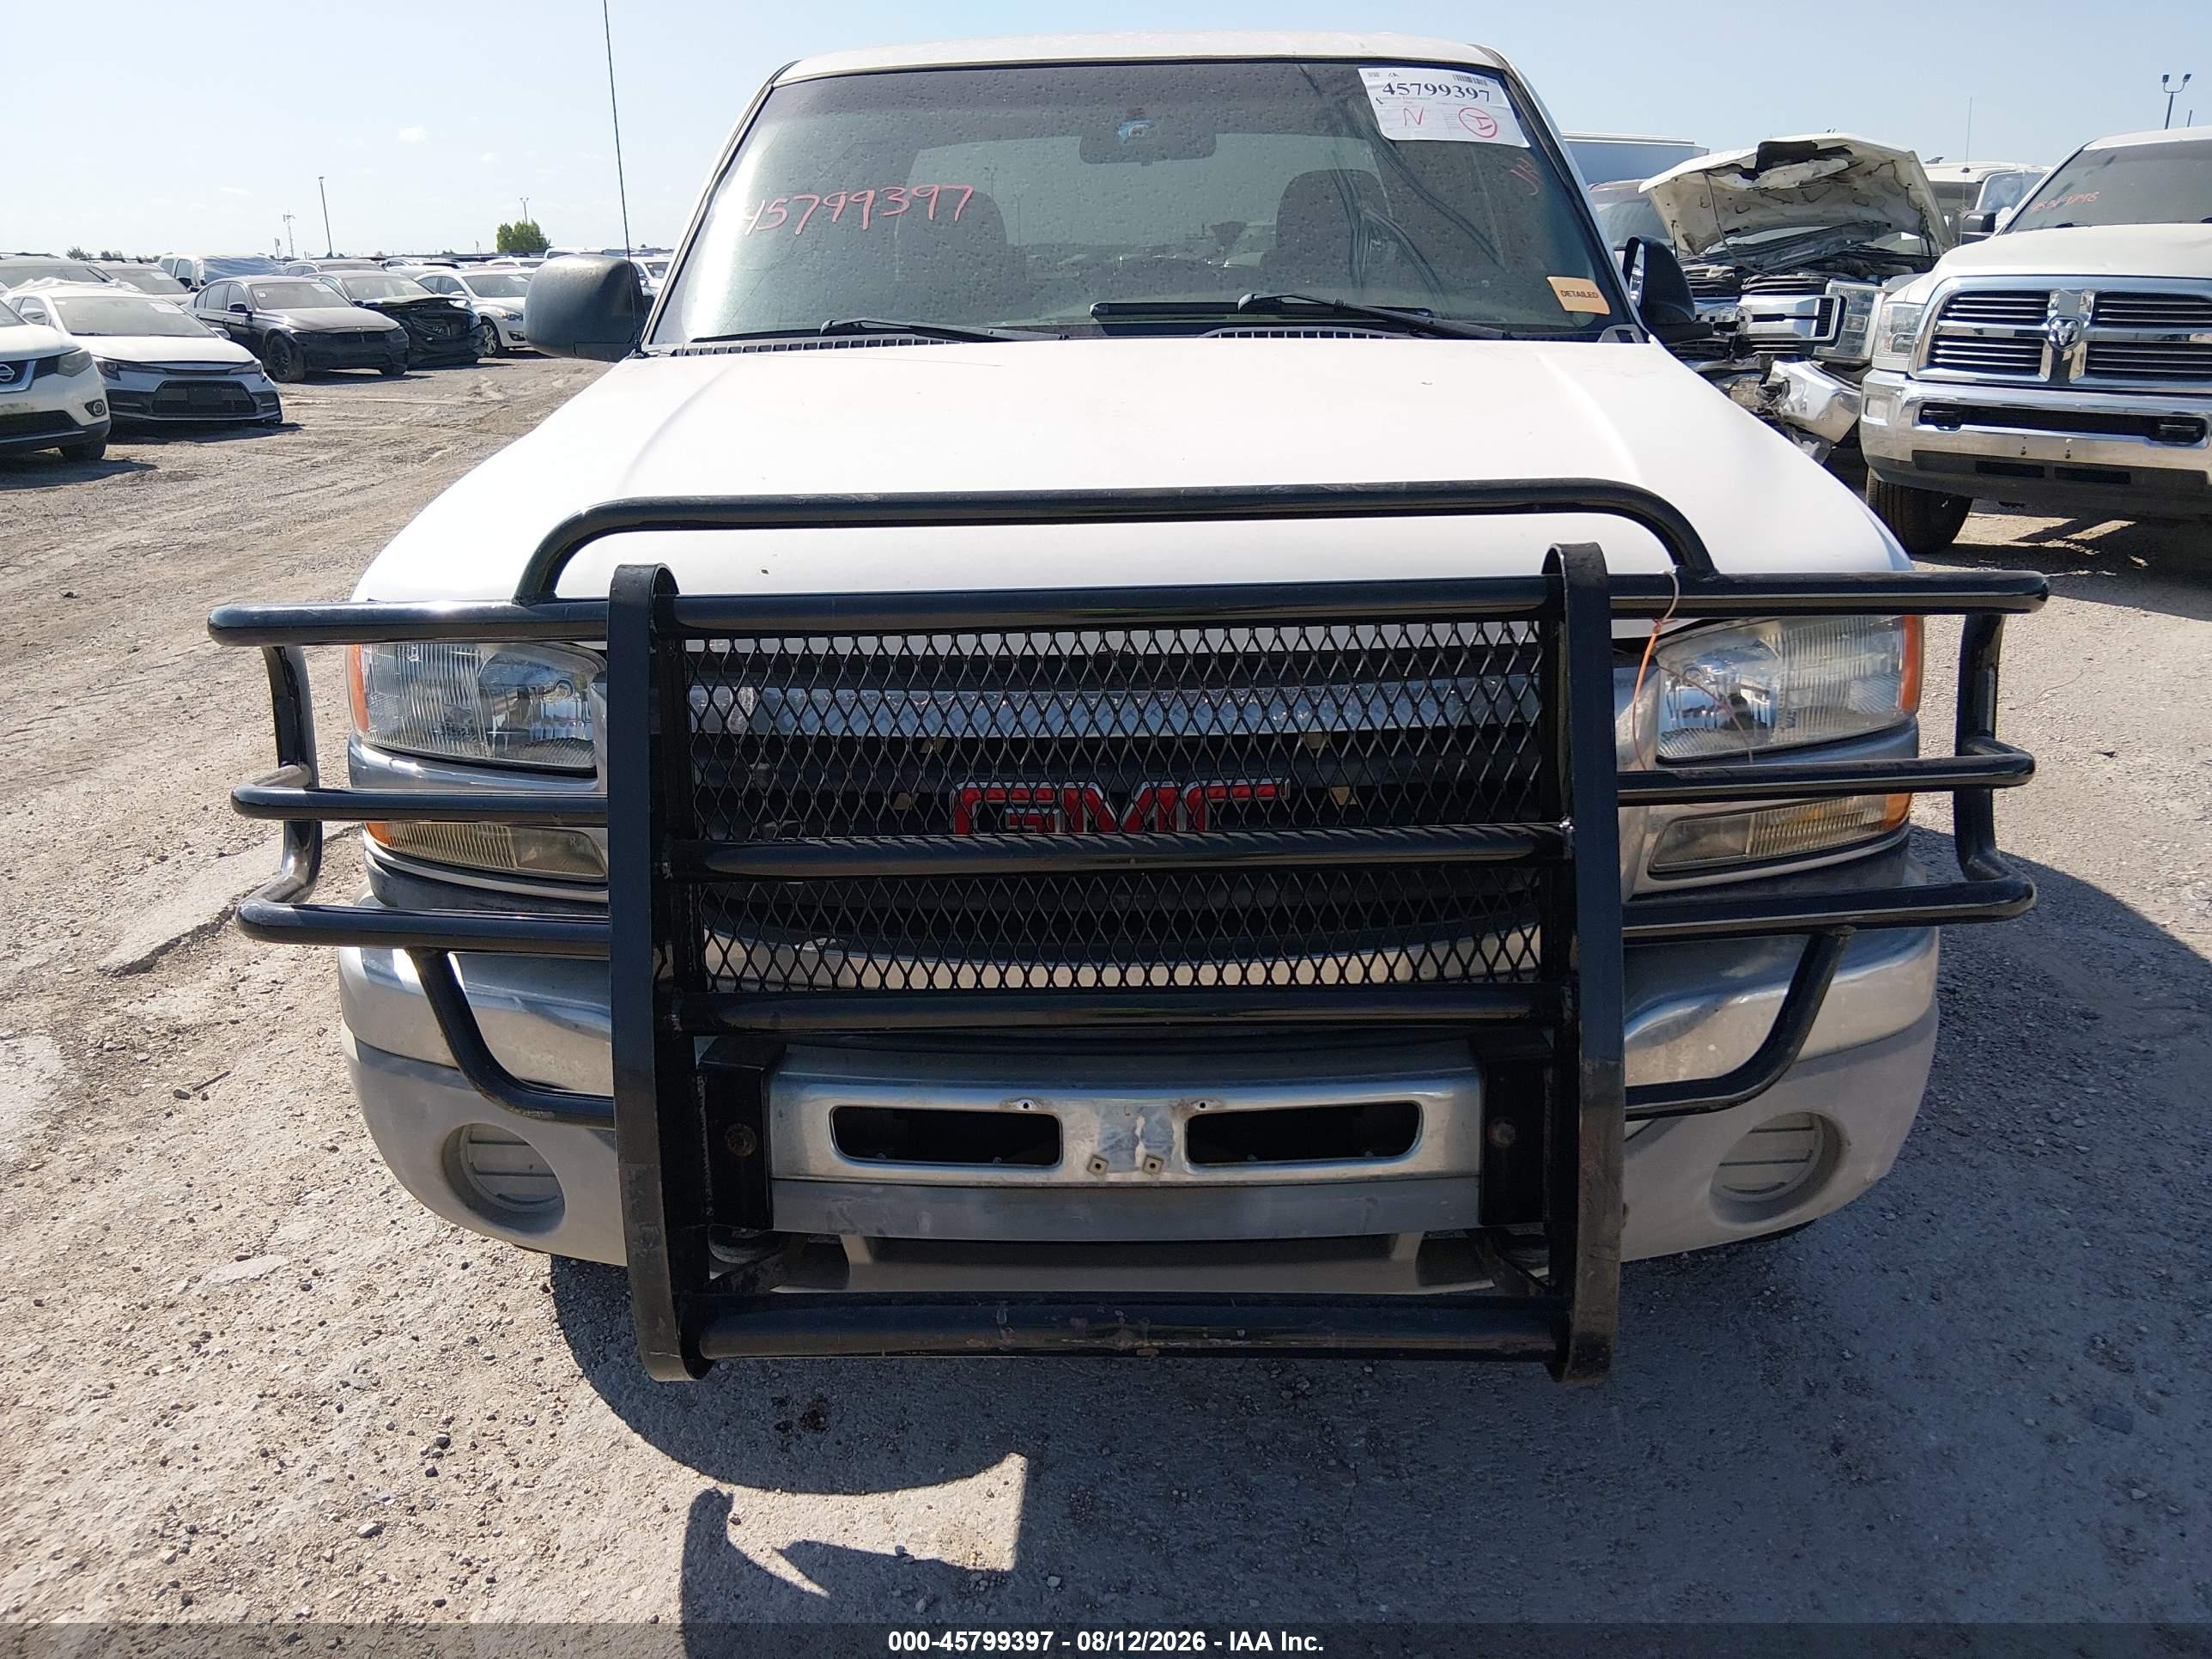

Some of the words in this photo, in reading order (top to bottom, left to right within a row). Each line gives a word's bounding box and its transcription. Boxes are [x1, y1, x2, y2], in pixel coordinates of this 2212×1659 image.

[1382, 82, 1490, 103] 45799397
[1403, 107, 1425, 127] N
[1559, 289, 1600, 299] DETAILED
[569, 836, 577, 847] R
